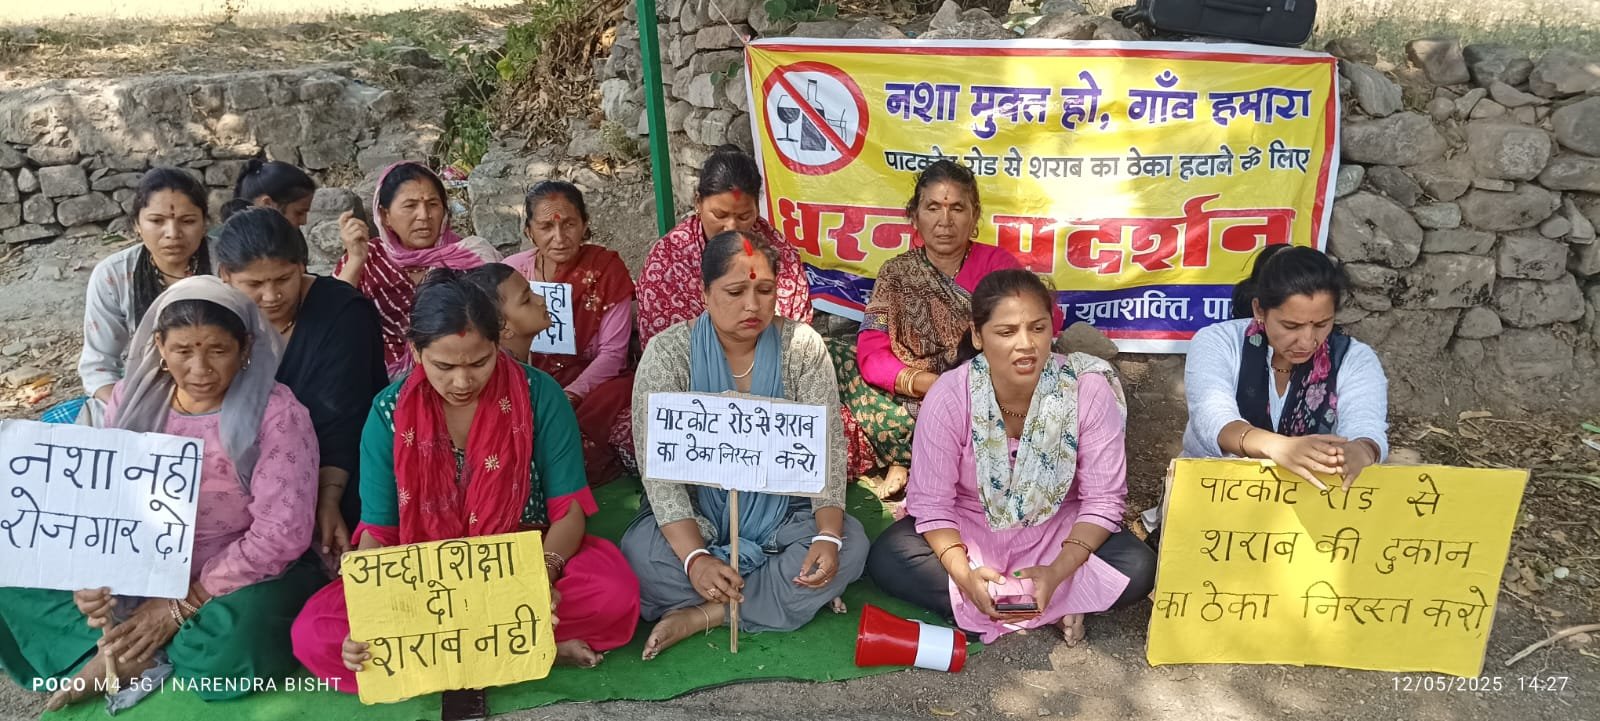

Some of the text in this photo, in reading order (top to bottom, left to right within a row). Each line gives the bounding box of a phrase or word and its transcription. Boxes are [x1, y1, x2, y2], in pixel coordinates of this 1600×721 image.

[885, 70, 1312, 139] नशा मुक्त हो, गाँव हमारा
[1004, 147, 1022, 177] से
[1029, 157, 1084, 179] शराब
[1091, 157, 1120, 177] का
[1127, 147, 1173, 177] ठेका
[1179, 145, 1234, 180] हटाने
[1269, 140, 1310, 173] लिए
[778, 197, 924, 262] धरन
[656, 398, 721, 433] पाटकोट
[754, 407, 770, 436] से
[774, 412, 819, 438] शराब
[9, 443, 118, 490] नशा
[657, 441, 679, 462] का
[686, 433, 715, 461] ठेका
[718, 442, 763, 467] निरस्त
[1200, 466, 1302, 505] पाटकोट
[1406, 473, 1445, 517] से
[0, 486, 142, 554] रोजगार
[433, 540, 515, 582] शिक्षा
[1200, 527, 1480, 575] शराब की दुकान
[1156, 591, 1193, 619] का
[1201, 580, 1279, 622] ठेका
[1301, 581, 1413, 625] निरस्त
[366, 627, 469, 677] शराब
